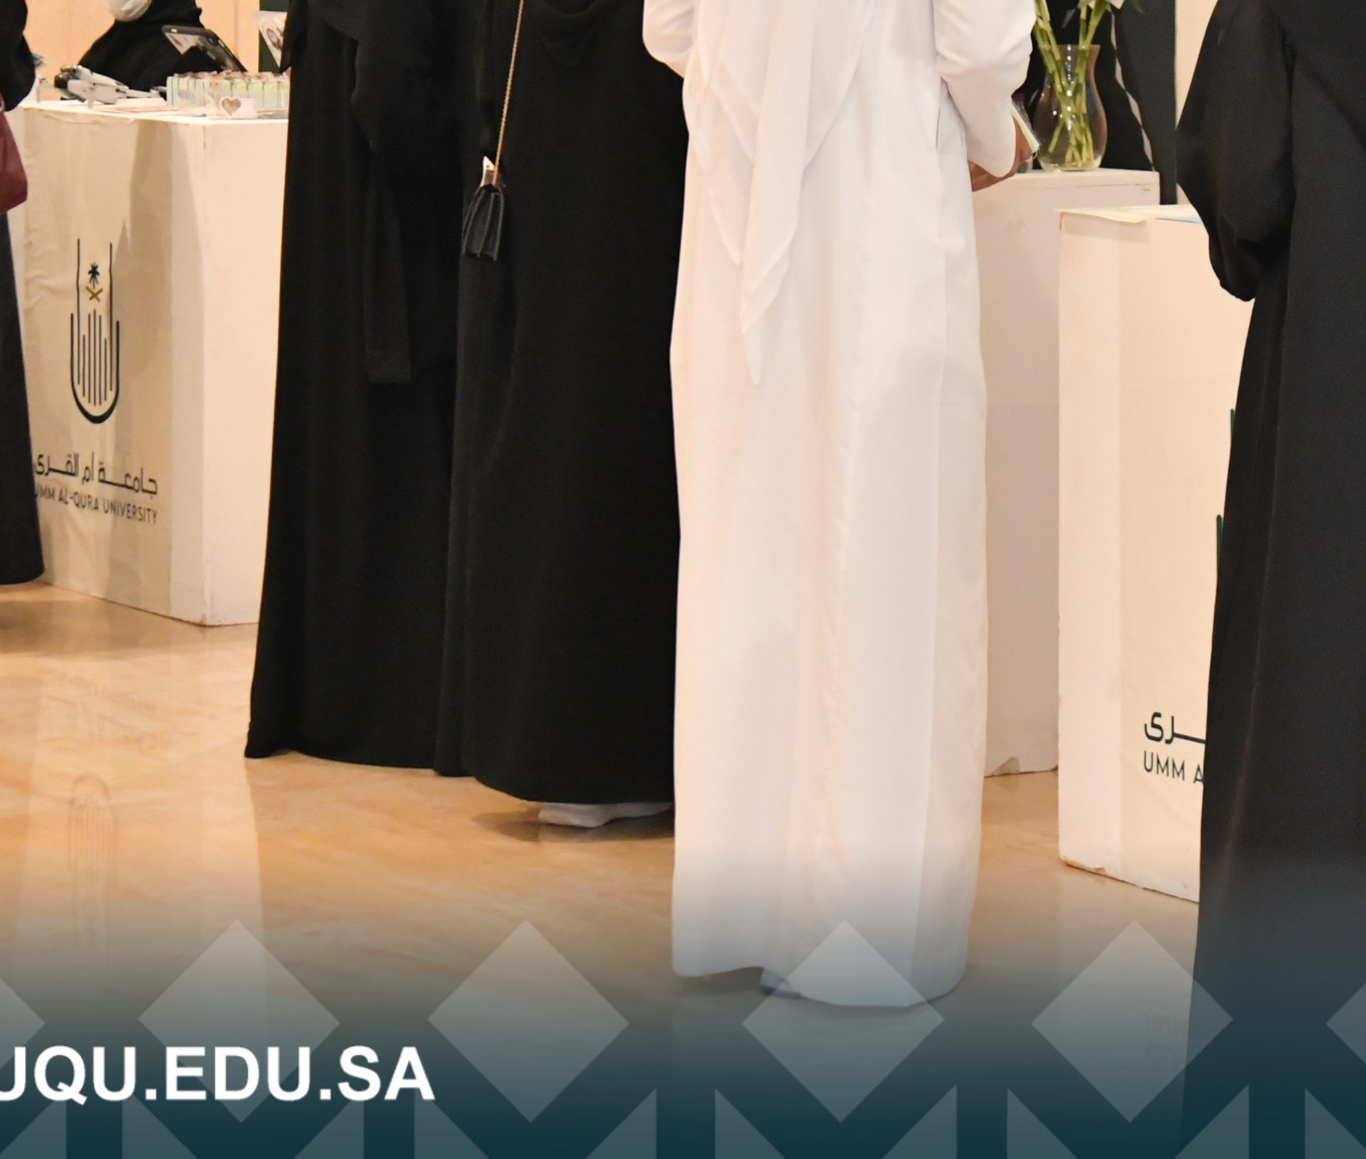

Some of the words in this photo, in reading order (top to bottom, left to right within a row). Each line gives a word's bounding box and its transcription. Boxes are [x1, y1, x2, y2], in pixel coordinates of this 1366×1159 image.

[58, 487, 99, 511] AL-QURA
[103, 498, 157, 524] UNIVERSITY
[1144, 750, 1185, 781] UMM
